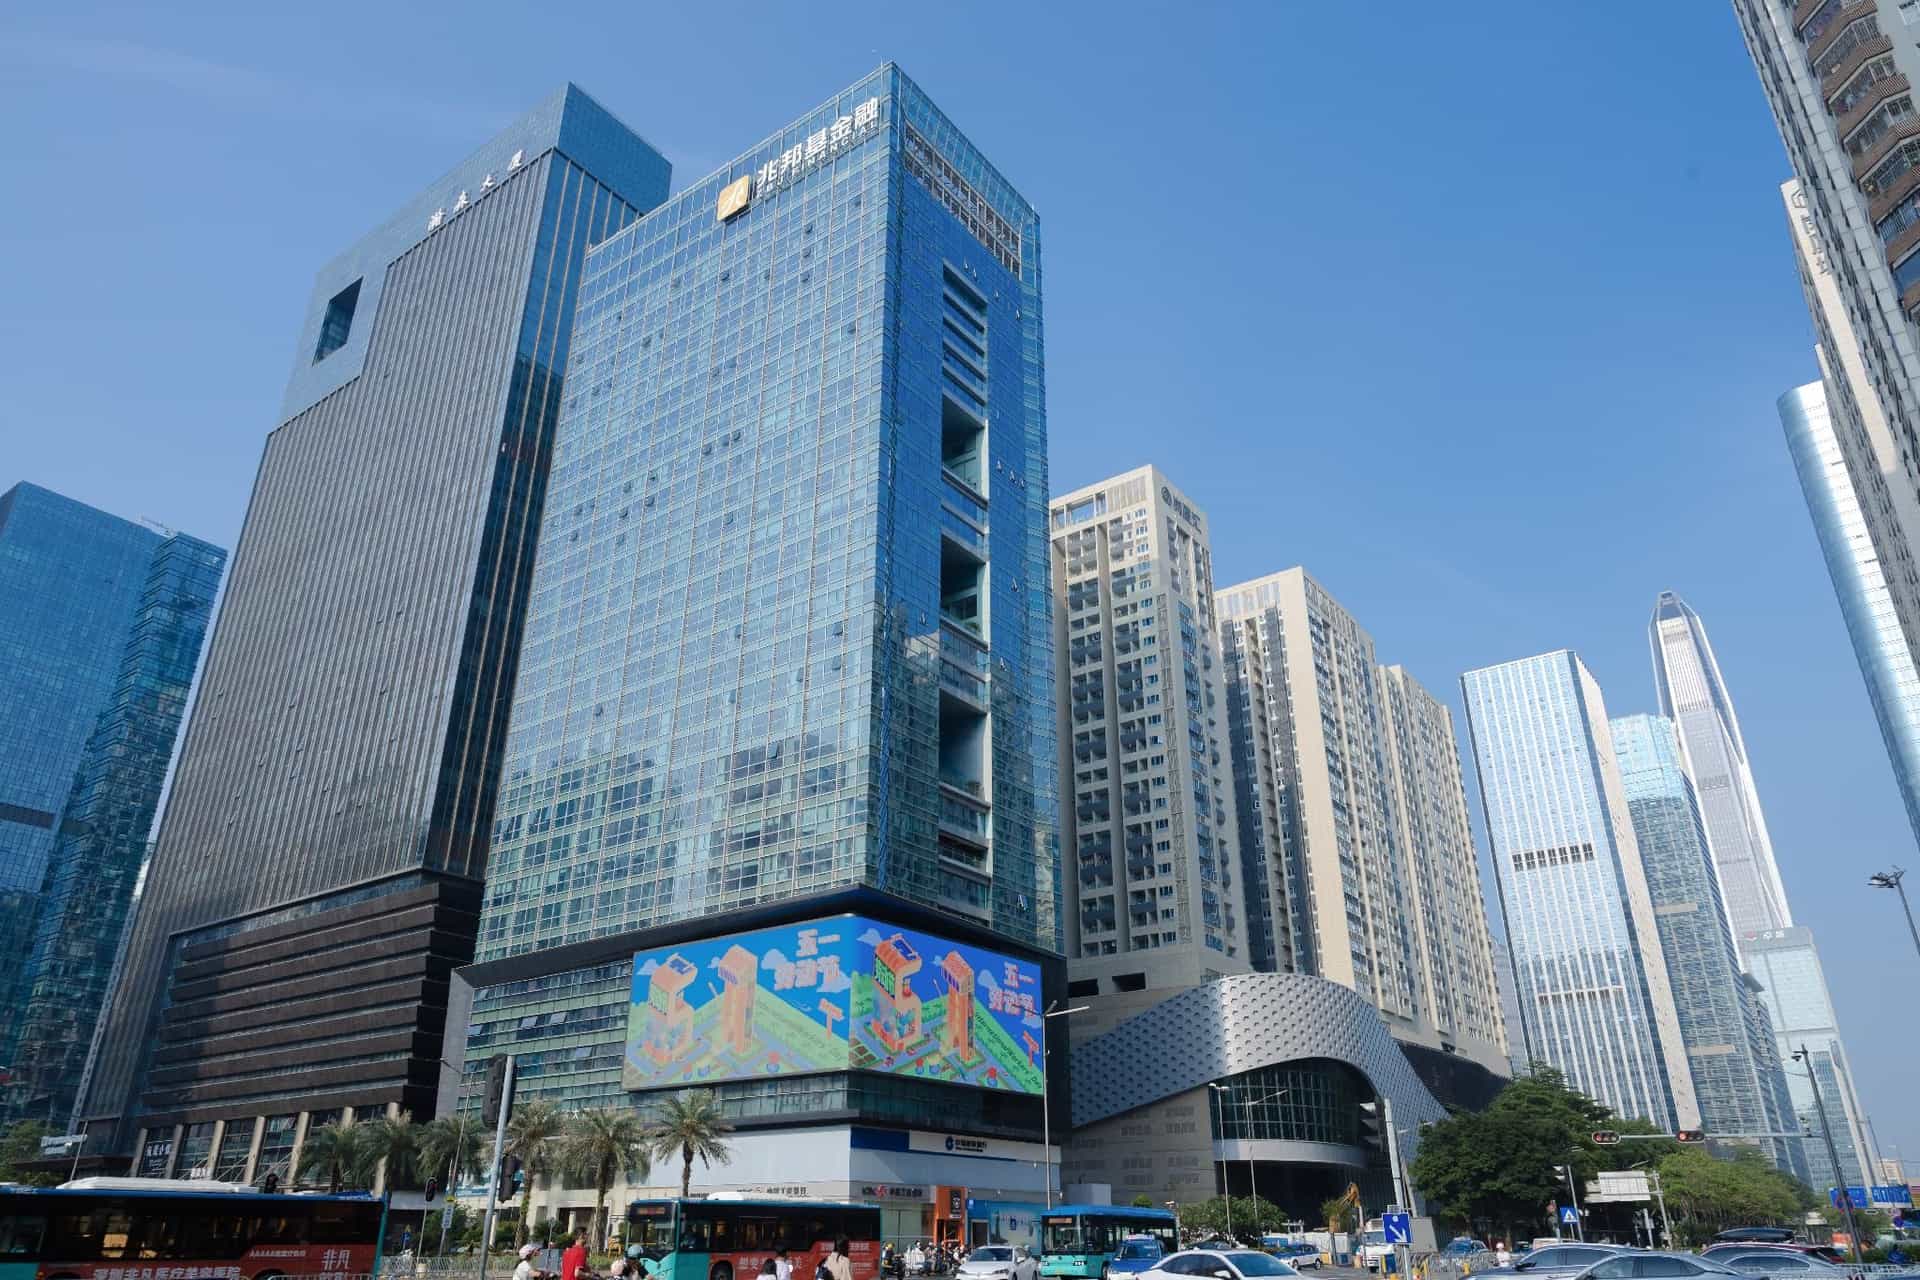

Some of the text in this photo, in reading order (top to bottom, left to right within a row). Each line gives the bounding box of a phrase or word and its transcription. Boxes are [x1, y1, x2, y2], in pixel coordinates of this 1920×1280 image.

[757, 98, 879, 186] 兆邦基金融
[796, 929, 840, 956] 五一
[774, 955, 842, 992] 劳动节
[1004, 961, 1034, 988] 五一
[988, 987, 1034, 1018] 劳动节
[322, 1249, 351, 1270] 非凡
